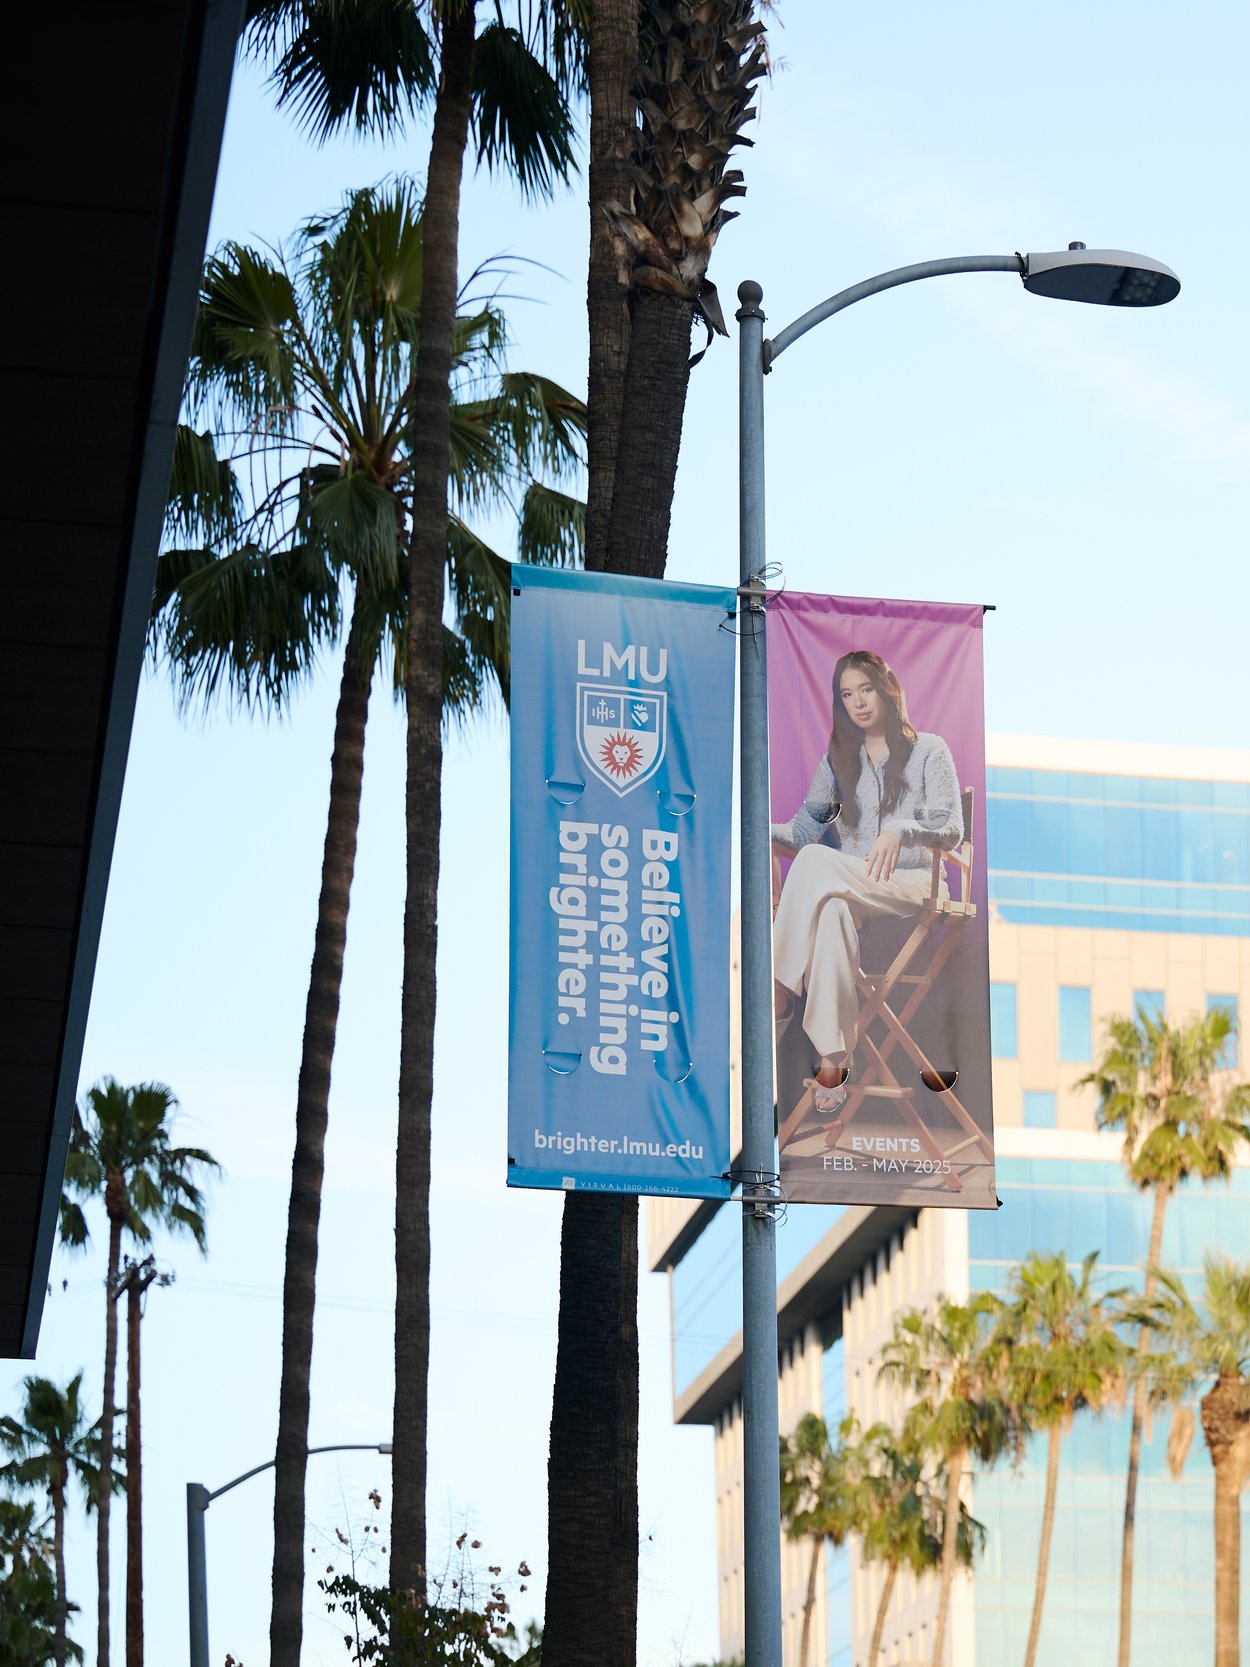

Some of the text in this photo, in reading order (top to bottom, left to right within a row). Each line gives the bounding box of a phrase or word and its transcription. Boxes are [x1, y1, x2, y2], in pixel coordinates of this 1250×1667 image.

[577, 639, 668, 684] LMU
[549, 820, 599, 1025] brighter.
[640, 828, 681, 1052] Believe in
[589, 823, 639, 1076] something
[534, 1129, 704, 1159] brighter.lmu.edu
[852, 1136, 921, 1152] EVENTS
[823, 1156, 857, 1171] FEB.
[873, 1158, 909, 1172] MAY
[914, 1159, 951, 1174] 2025
[580, 1181, 621, 1190] VISUAL
